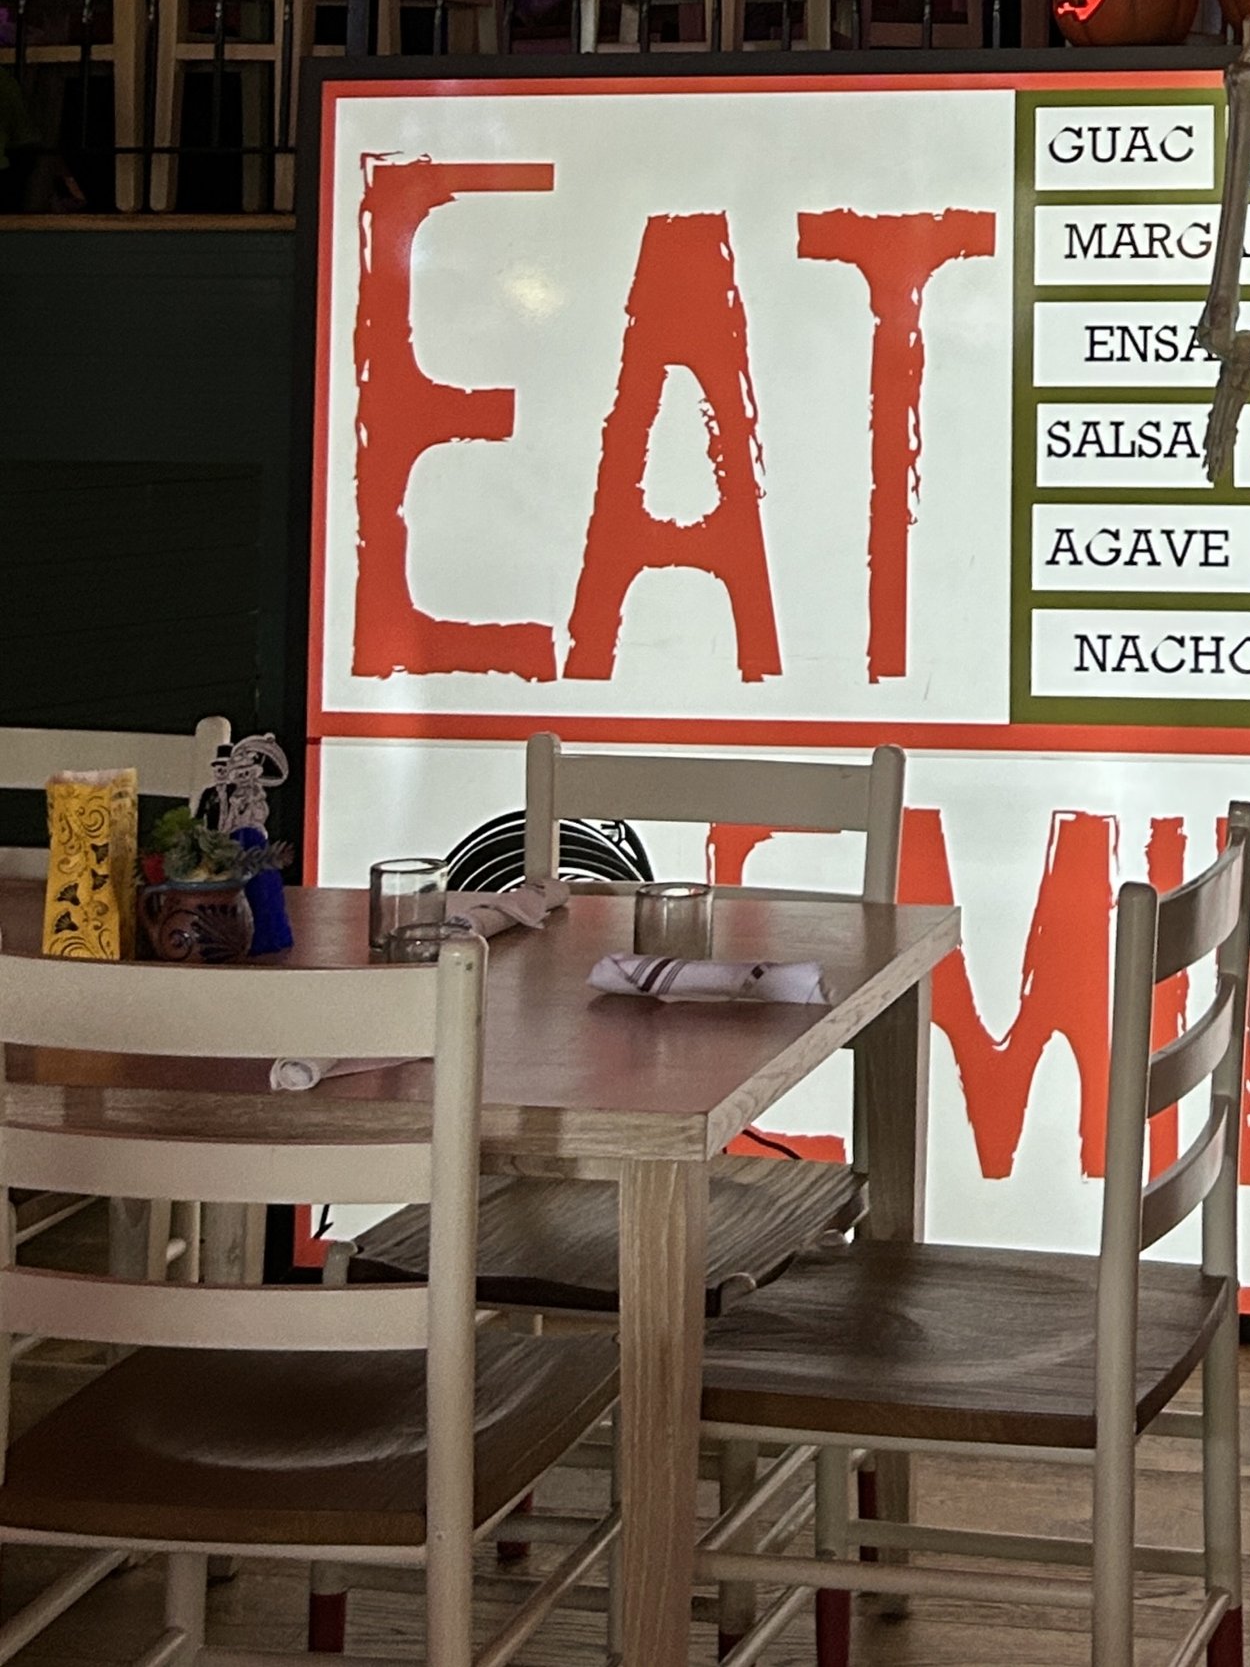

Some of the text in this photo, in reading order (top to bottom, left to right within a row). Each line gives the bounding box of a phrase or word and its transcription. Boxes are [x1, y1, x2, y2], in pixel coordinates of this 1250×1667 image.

[1048, 125, 1194, 163] GUAC
[352, 151, 997, 684] EAT
[1047, 420, 1201, 459] SALSA
[1045, 528, 1229, 567] AGAVE
